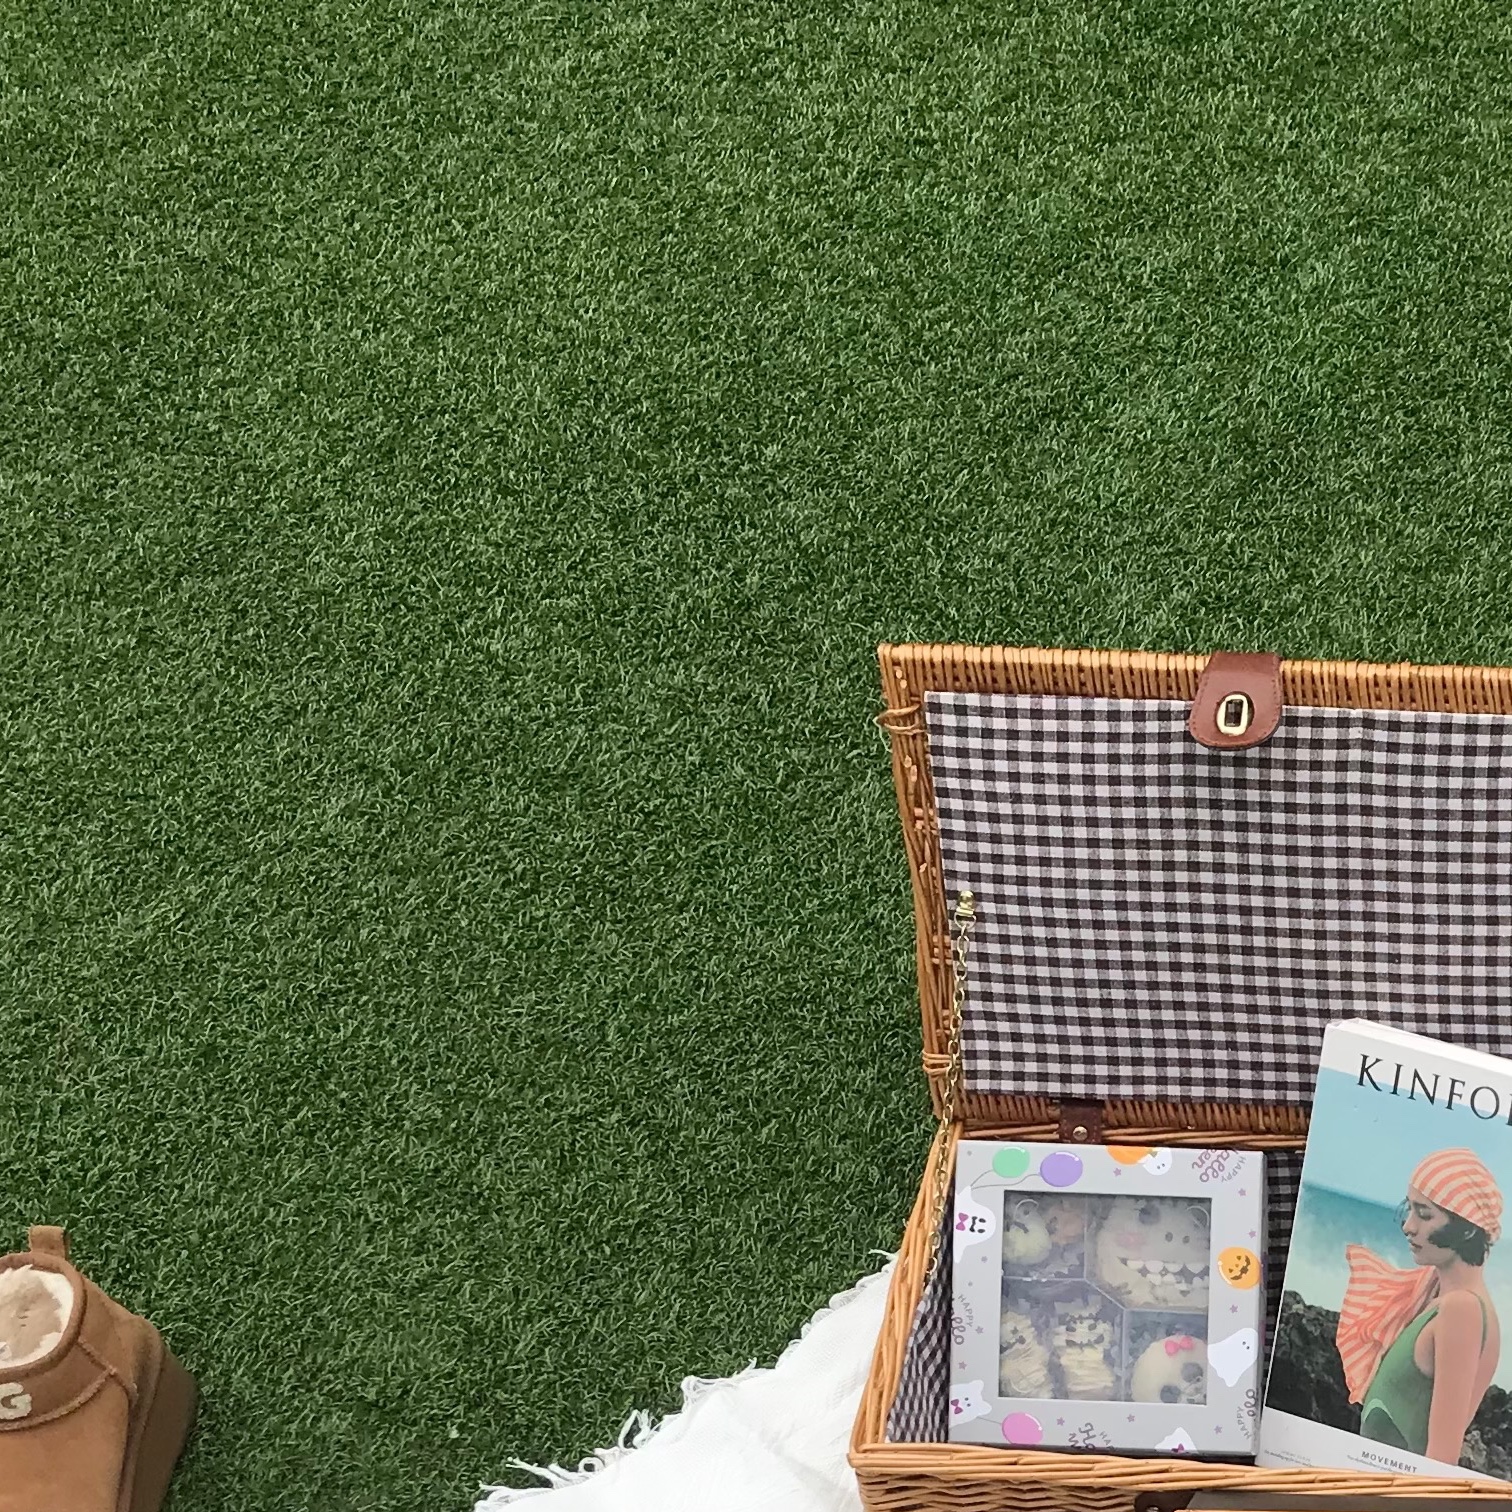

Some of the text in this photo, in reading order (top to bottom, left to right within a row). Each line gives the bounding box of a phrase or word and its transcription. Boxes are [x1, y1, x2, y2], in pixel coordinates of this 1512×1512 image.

[1220, 1156, 1247, 1183] HAPPY
[957, 1294, 974, 1328] HAPPY
[1236, 1406, 1252, 1441] HAPPY
[1361, 1450, 1418, 1474] MOVEMENT
